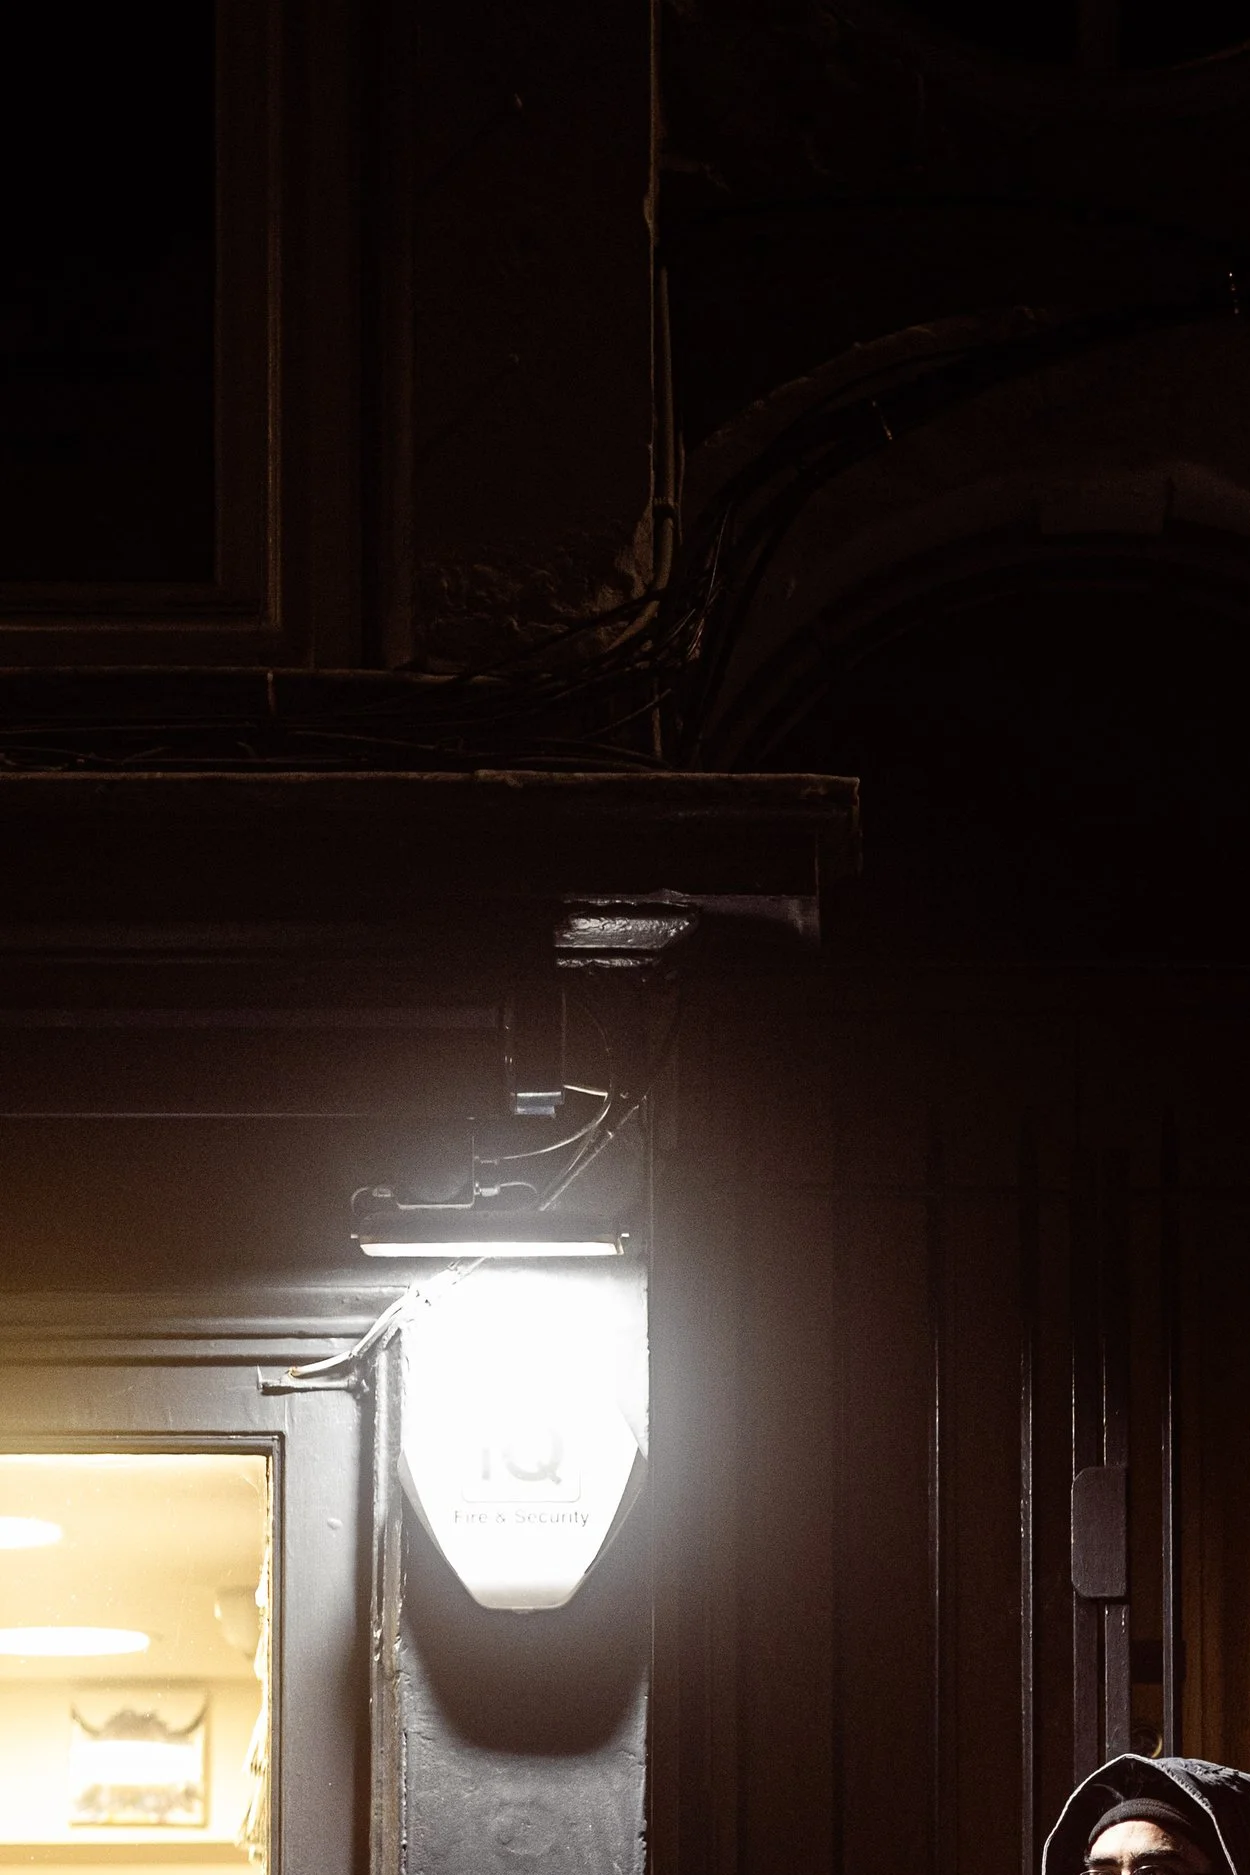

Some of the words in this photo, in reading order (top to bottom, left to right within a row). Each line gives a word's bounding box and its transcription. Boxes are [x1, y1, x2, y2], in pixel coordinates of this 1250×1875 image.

[453, 1509, 488, 1525] Fire
[494, 1512, 506, 1525] &
[514, 1509, 590, 1528] Security
